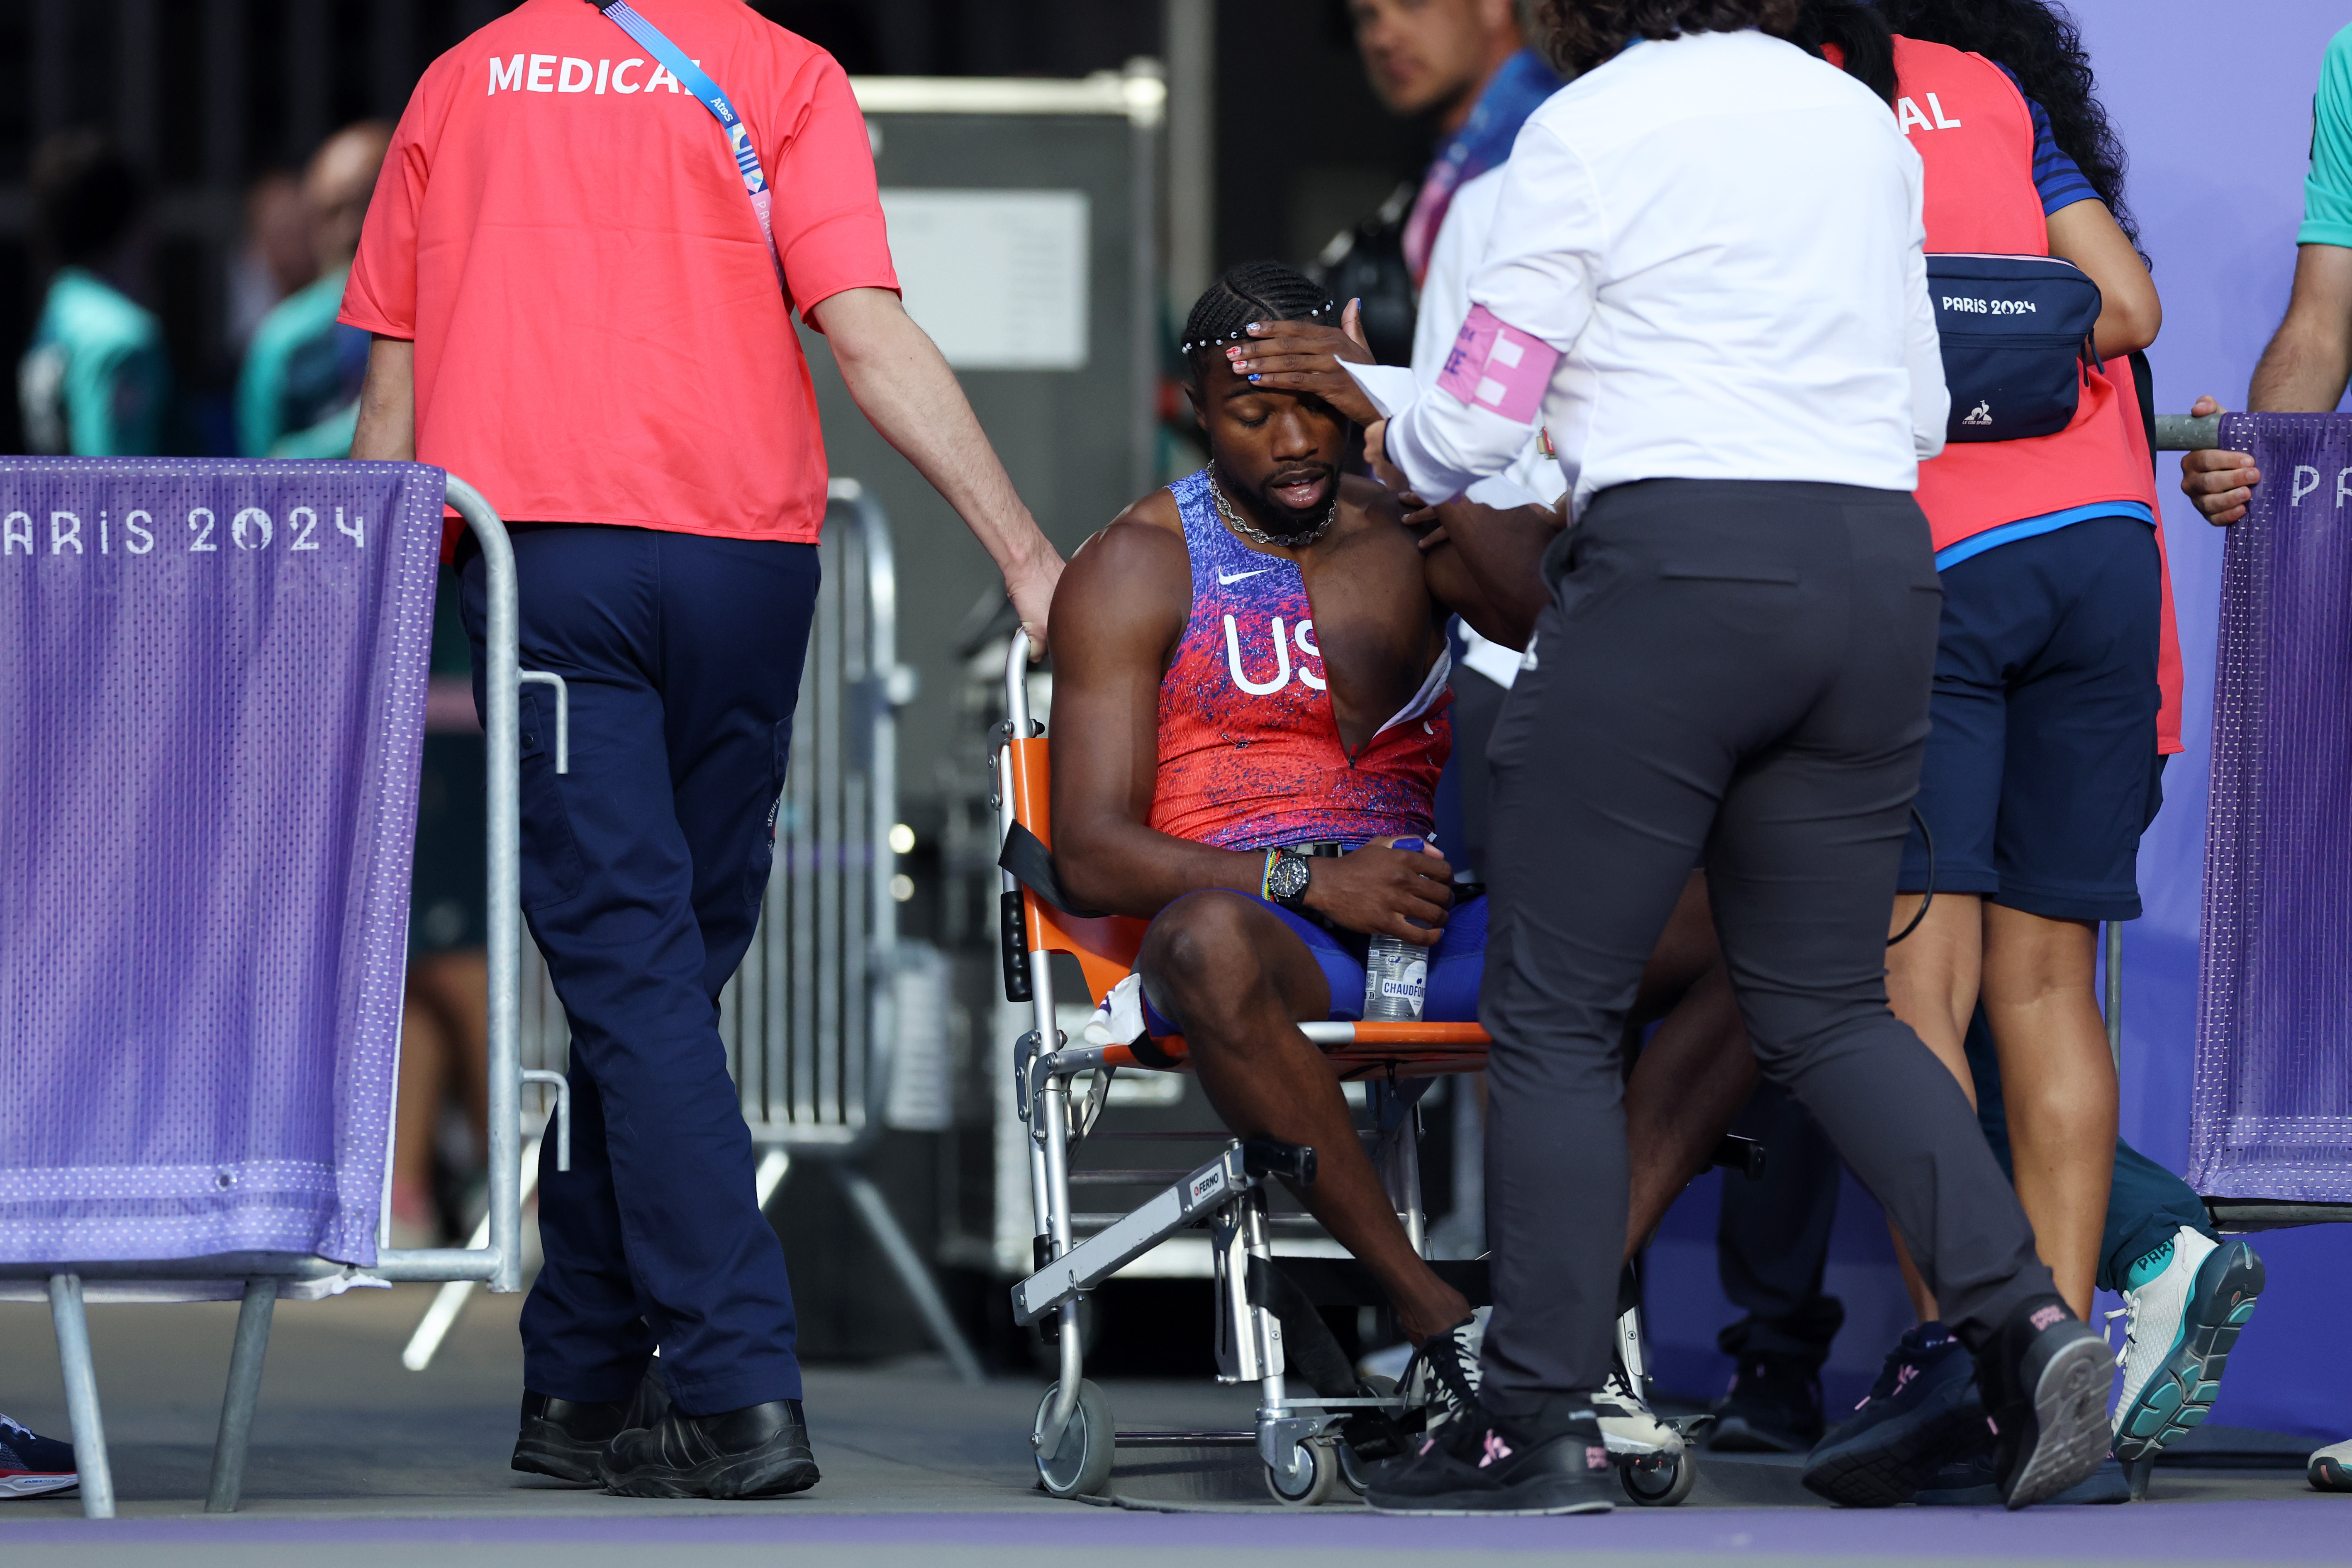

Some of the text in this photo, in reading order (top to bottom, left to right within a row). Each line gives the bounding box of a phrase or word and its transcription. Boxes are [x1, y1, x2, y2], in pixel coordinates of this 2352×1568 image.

[710, 97, 734, 122] Atos
[1990, 300, 2036, 315] 2024
[188, 506, 364, 552] 2024
[1199, 1173, 1219, 1194] FERNO
